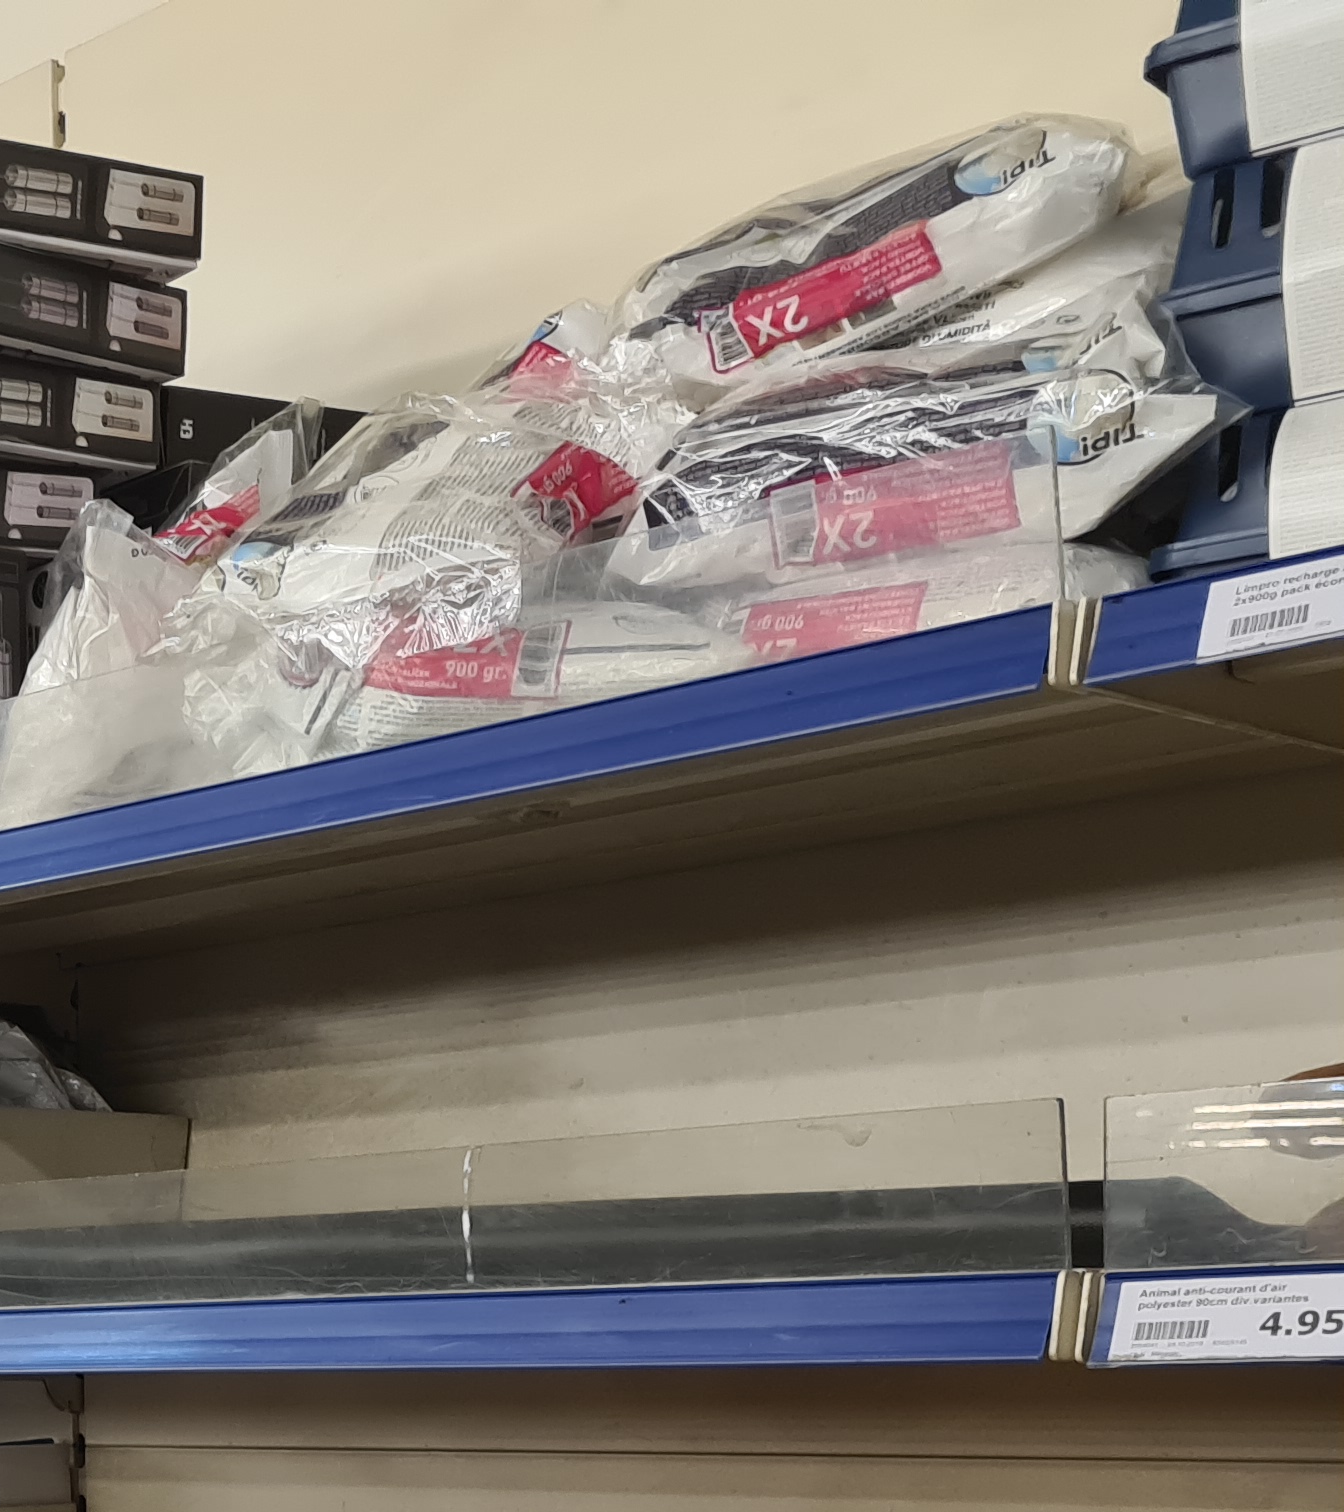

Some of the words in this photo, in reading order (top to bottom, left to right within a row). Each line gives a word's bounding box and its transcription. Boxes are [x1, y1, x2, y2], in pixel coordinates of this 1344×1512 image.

[744, 294, 809, 346] 2X
[1081, 422, 1144, 457] Tipi
[822, 510, 877, 555] 2X
[1235, 579, 1281, 597] Limpro
[1284, 566, 1341, 585] recharge
[1281, 584, 1310, 598] pack
[445, 661, 479, 680] 900
[1137, 1298, 1193, 1312] polyester
[1195, 1296, 1229, 1308] 90cm
[1139, 1286, 1182, 1299] Animal
[1183, 1284, 1257, 1297] anti-courant
[1259, 1282, 1289, 1293] d'air
[1258, 1309, 1344, 1338] 4.95
